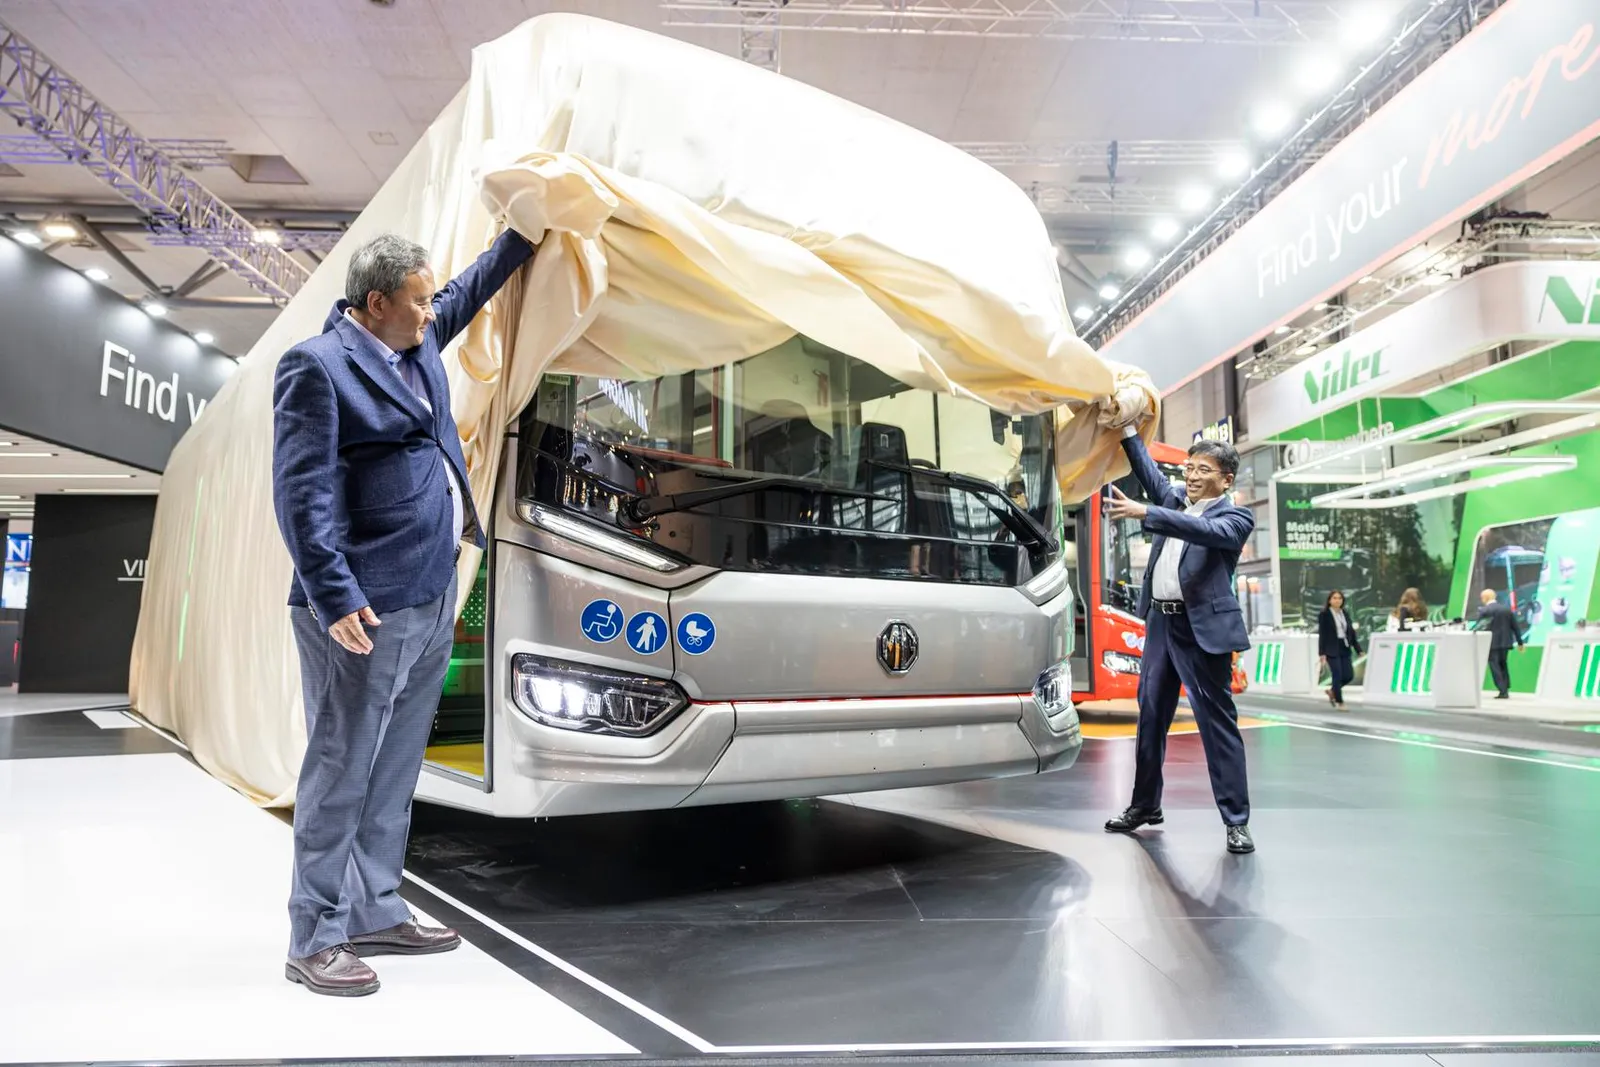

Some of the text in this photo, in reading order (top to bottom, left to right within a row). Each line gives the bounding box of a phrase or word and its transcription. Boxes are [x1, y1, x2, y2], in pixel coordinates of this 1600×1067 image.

[1256, 23, 1600, 298] Find your more
[100, 340, 179, 423] Find
[1303, 344, 1391, 404] Nidec
[1286, 522, 1330, 533] Motion
[1286, 532, 1325, 542] starts
[1286, 541, 1339, 551] within to
